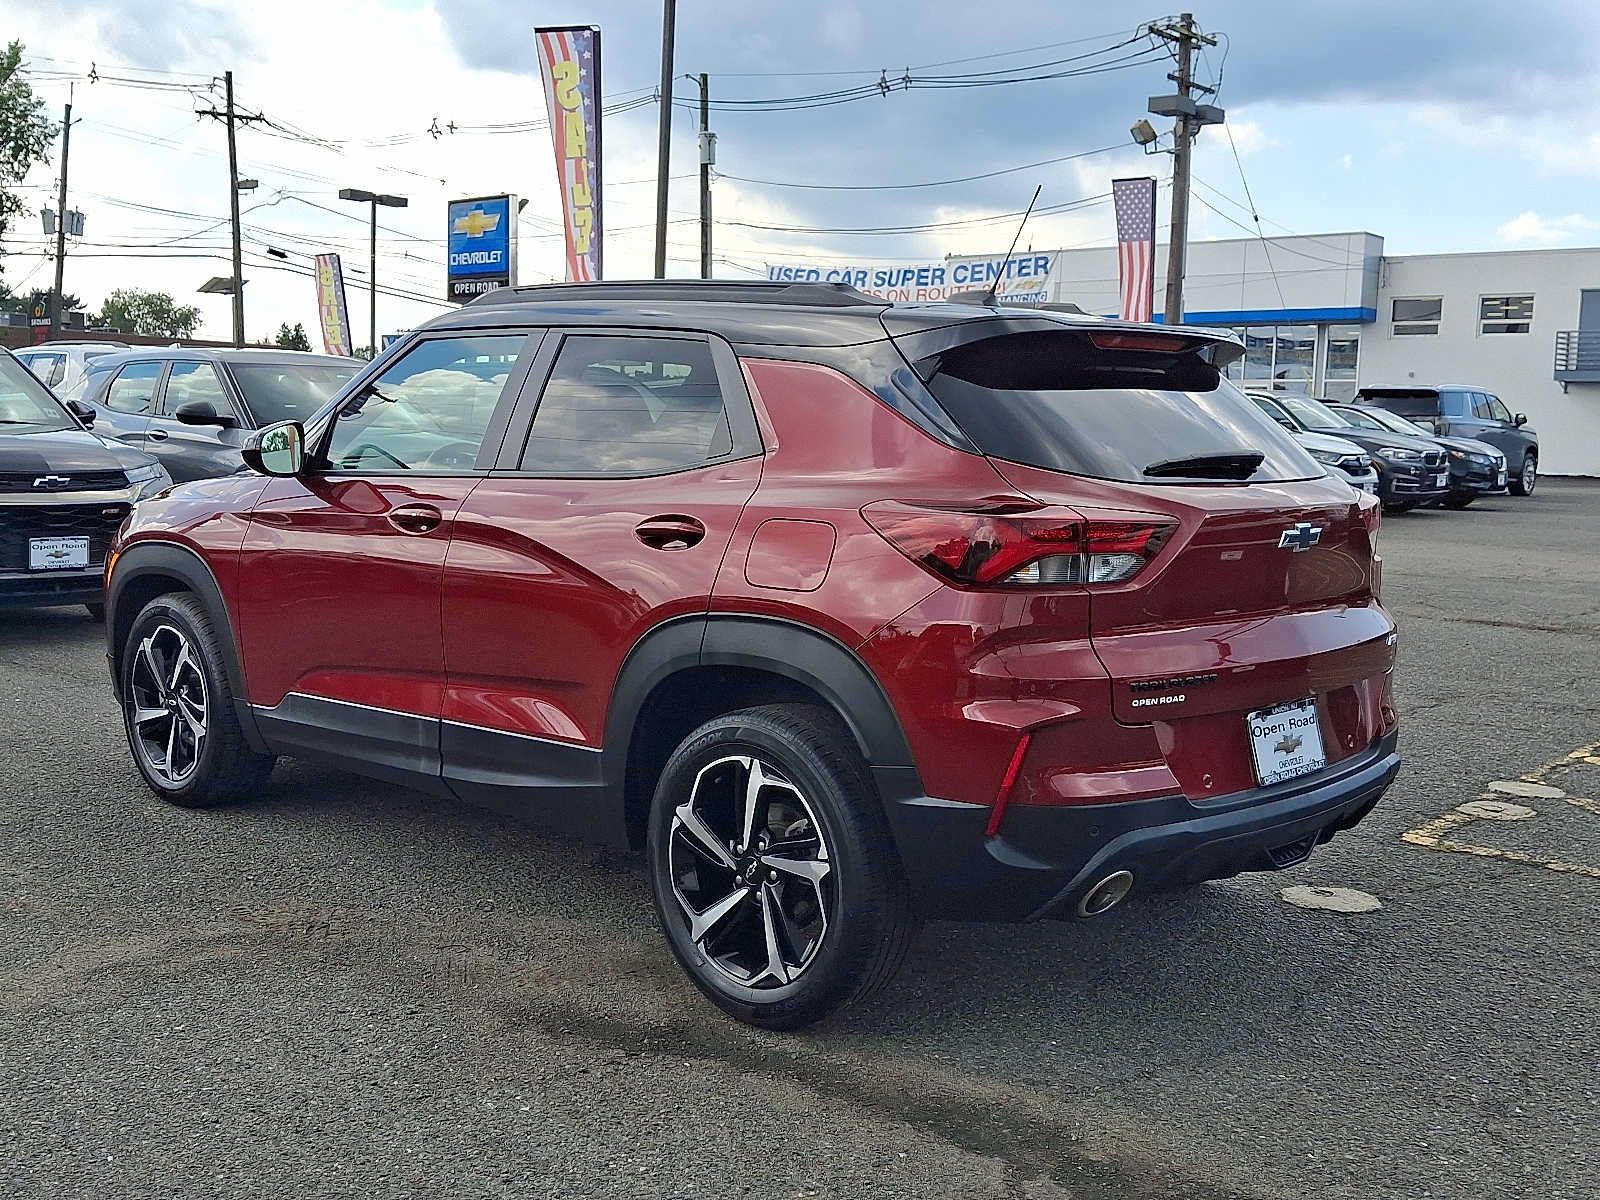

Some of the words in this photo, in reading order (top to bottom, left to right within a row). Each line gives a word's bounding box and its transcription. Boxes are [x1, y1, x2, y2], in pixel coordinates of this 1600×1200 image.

[450, 250, 503, 266] CHEVROLET
[769, 266, 820, 281] USED
[826, 270, 868, 288] CAR
[873, 267, 946, 288] SUPER
[952, 256, 1050, 284] CENTER
[454, 283, 476, 295] OPEN
[476, 281, 499, 293] ROAD
[1131, 698, 1158, 707] OPEN
[1159, 694, 1186, 705] ROAD
[1252, 722, 1286, 739] Open
[1288, 713, 1316, 730] Road
